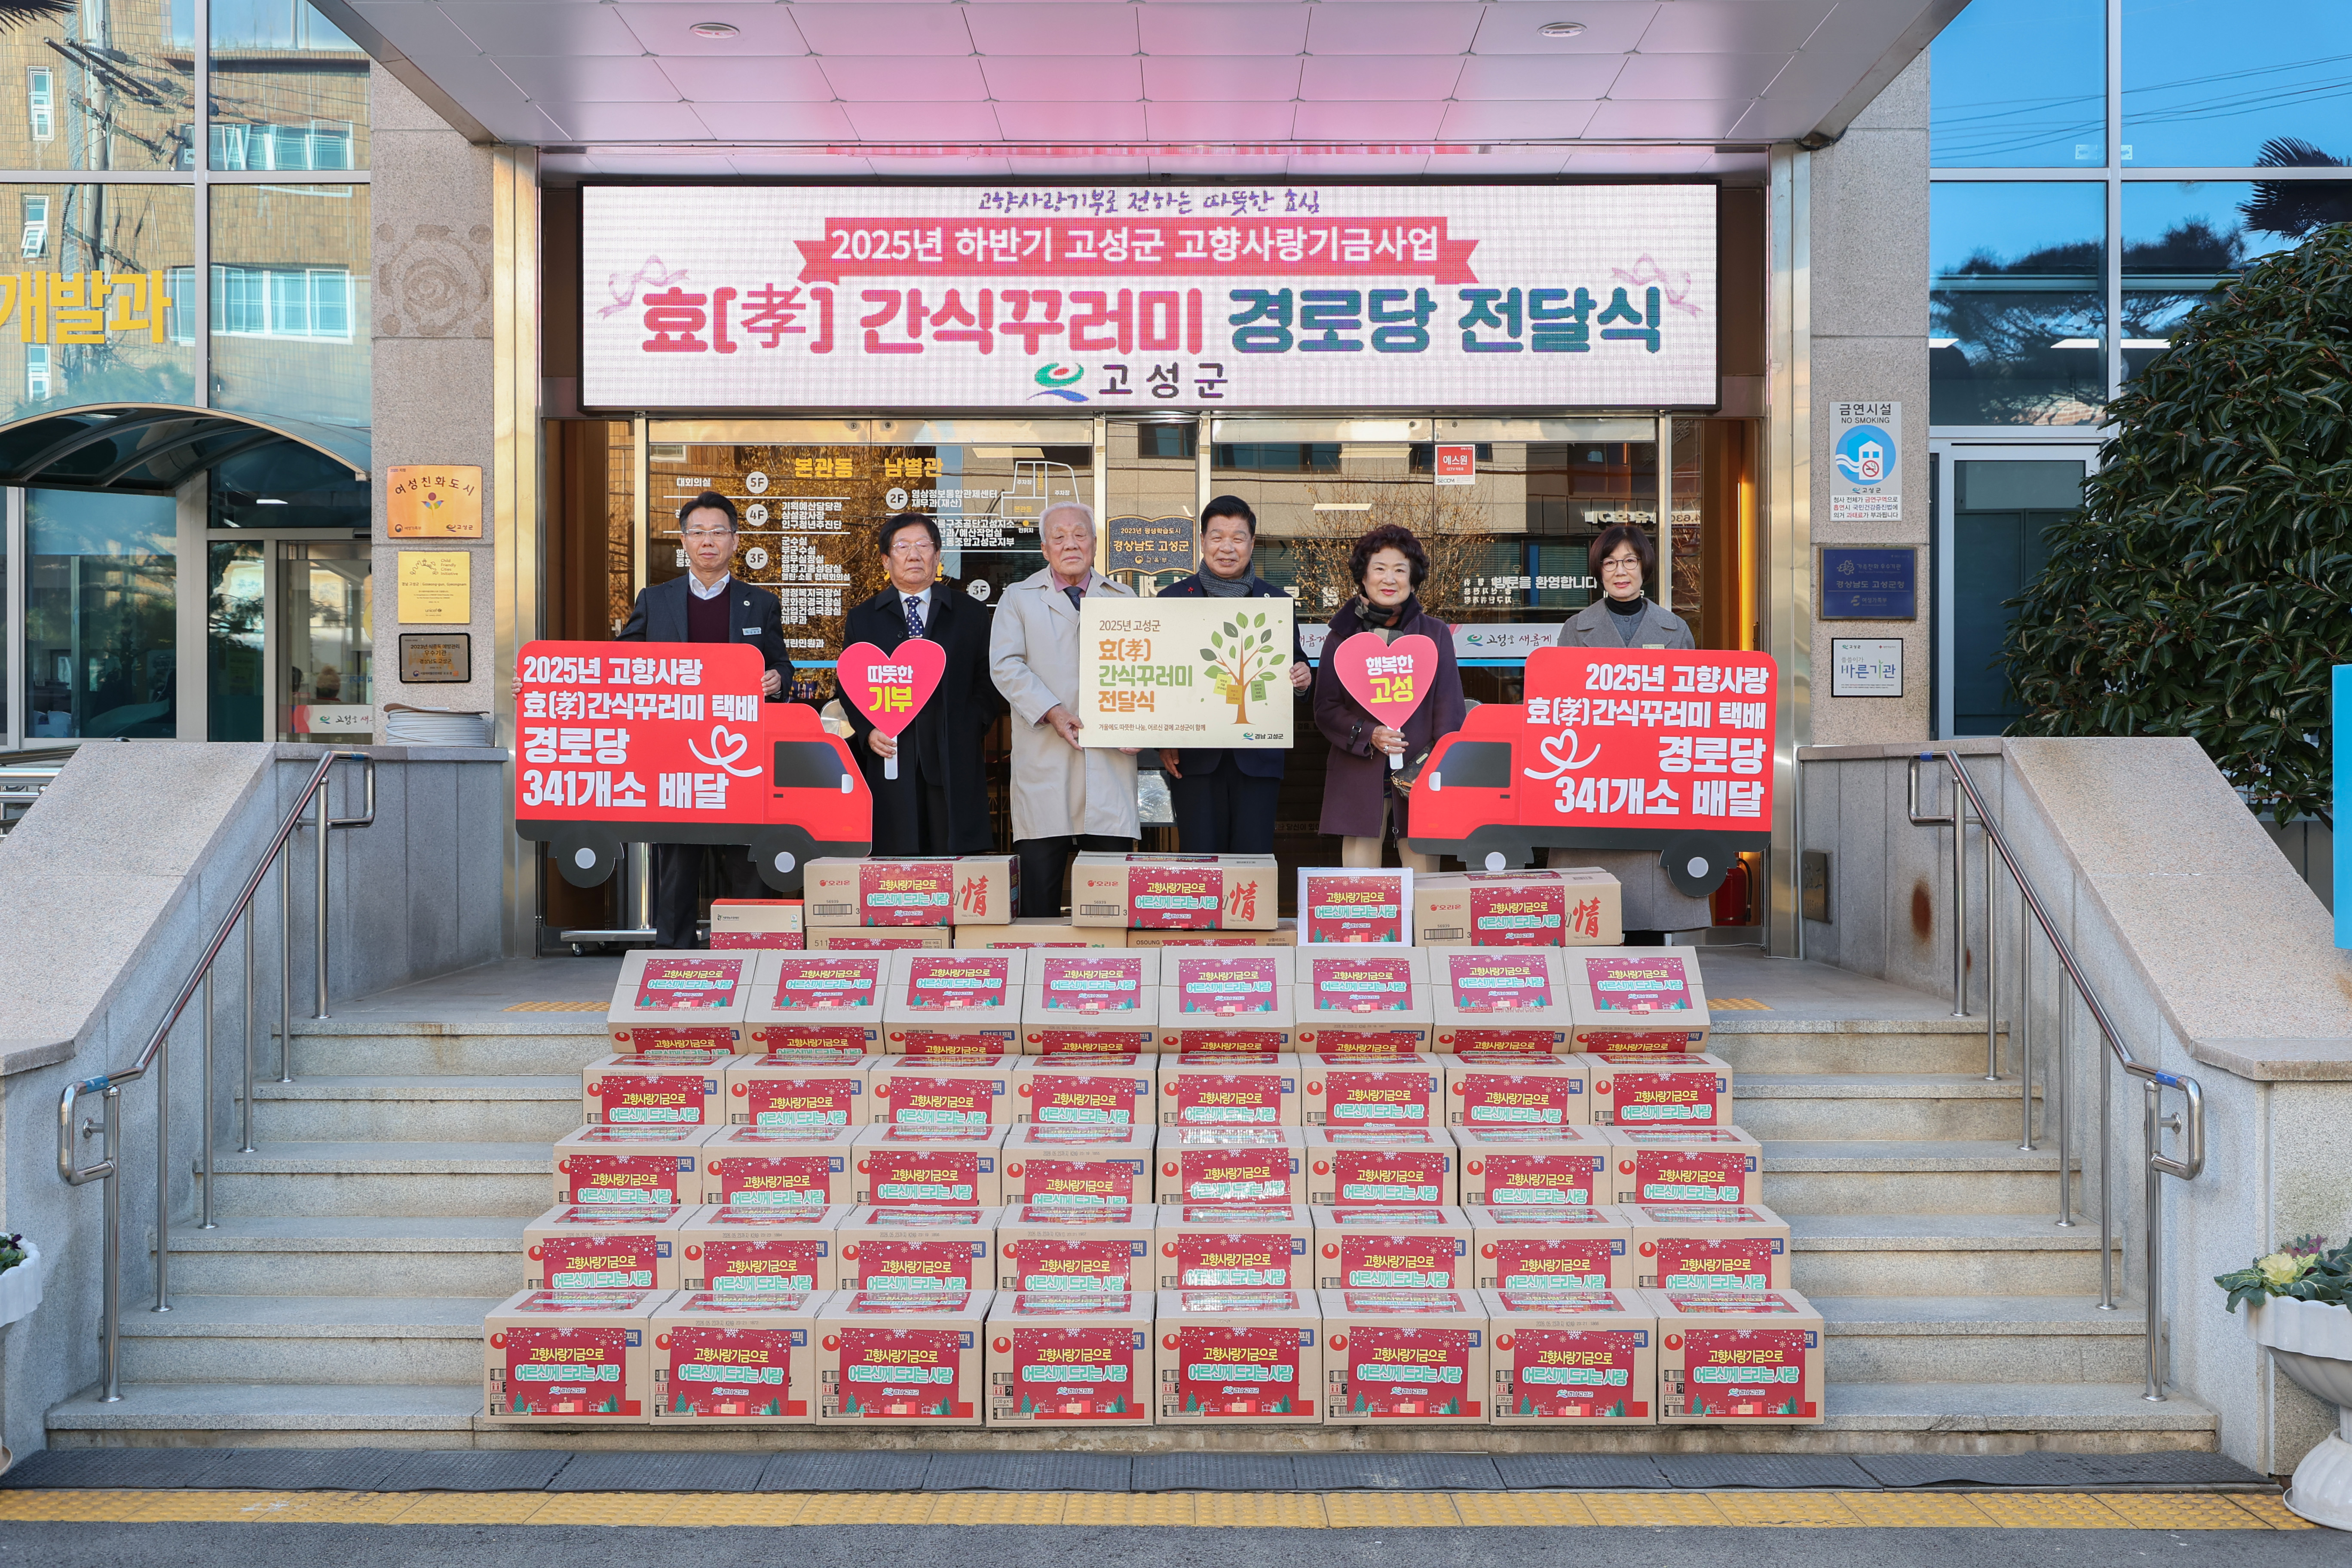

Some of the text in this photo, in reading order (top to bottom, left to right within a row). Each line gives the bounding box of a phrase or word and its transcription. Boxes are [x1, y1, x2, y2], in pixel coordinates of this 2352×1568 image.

[979, 190, 1321, 215] 고향사랑기부로 전하는 따뜻한 효심
[830, 226, 1438, 261] 2025년 하반기 고성군 고향사랑기금사업
[642, 283, 1661, 355] 효[孝] 간식꾸러미 경로당 전달식
[1099, 363, 1227, 398] 고성군
[1839, 404, 1891, 416] 금연시설
[1443, 455, 1467, 465] 에스원
[795, 458, 853, 478] 본관동
[884, 457, 943, 478] 남별관
[395, 476, 475, 496] 여성친화도시
[677, 478, 711, 487] 대회의실
[750, 478, 764, 487] 5F
[891, 493, 903, 504] 2F
[912, 489, 997, 499] 영상정보통합관제센터
[781, 502, 842, 511] 기획예산담당관
[912, 498, 962, 508] 재무과(재산)
[750, 510, 764, 520] 4F
[781, 511, 825, 520] 상설감사장
[781, 521, 842, 530] 인구청년추진단
[781, 536, 807, 545] 군수실
[1112, 540, 1189, 552] 경상남도 고성군
[781, 545, 815, 554] 부군수실
[750, 553, 764, 563] 3F
[781, 555, 824, 564] 정무실장실
[781, 564, 841, 573] 행정고충상담실
[1494, 576, 1531, 589] 방문을
[1535, 576, 1597, 589] 환영합니다
[781, 588, 841, 597] 행정복지국장실
[973, 585, 987, 595] 3F
[781, 597, 841, 606] 문화환경국장실
[781, 606, 841, 616] 산업건설국장실
[781, 616, 807, 625] 재무과
[1099, 620, 1161, 632] 2025년 고성군
[1486, 633, 1552, 645] 고성을 새롭게
[524, 656, 703, 686] 2025년 고향사랑
[1366, 655, 1413, 676] 행복한
[1841, 663, 1896, 679] 바른기관
[867, 665, 913, 683] 따뜻한
[1099, 665, 1192, 687] 간식꾸러미
[1586, 663, 1769, 694] 2025년 고향사랑
[1370, 676, 1414, 703] 고성
[869, 686, 913, 712] 기부
[1098, 690, 1154, 712] 전달식
[712, 694, 759, 722] 택배
[1719, 701, 1766, 730] 택배
[524, 727, 631, 764] 경로당
[1659, 736, 1766, 774] 경로당
[523, 769, 729, 809] 341개소 배달
[1555, 778, 1764, 818] 341개소 배달
[878, 880, 937, 891] 고향사랑기금으로
[867, 893, 949, 907] 어르신께 드리는 사랑
[961, 875, 989, 916] 情
[1229, 880, 1259, 921] 情
[1326, 892, 1385, 903] 고향사랑기금으로
[1572, 897, 1601, 938] 情
[1608, 970, 1669, 979] 고향사랑기금으로
[1598, 980, 1683, 991] 어르신께 드리는 사랑
[626, 1332, 638, 1344] 팩
[530, 1348, 605, 1361] 고향사랑기금으로
[1708, 1350, 1784, 1363] 고향사랑기금으로
[515, 1365, 620, 1381] 어르신께 드리는 사랑
[1694, 1366, 1799, 1383] 어르신께 드리는 사랑
